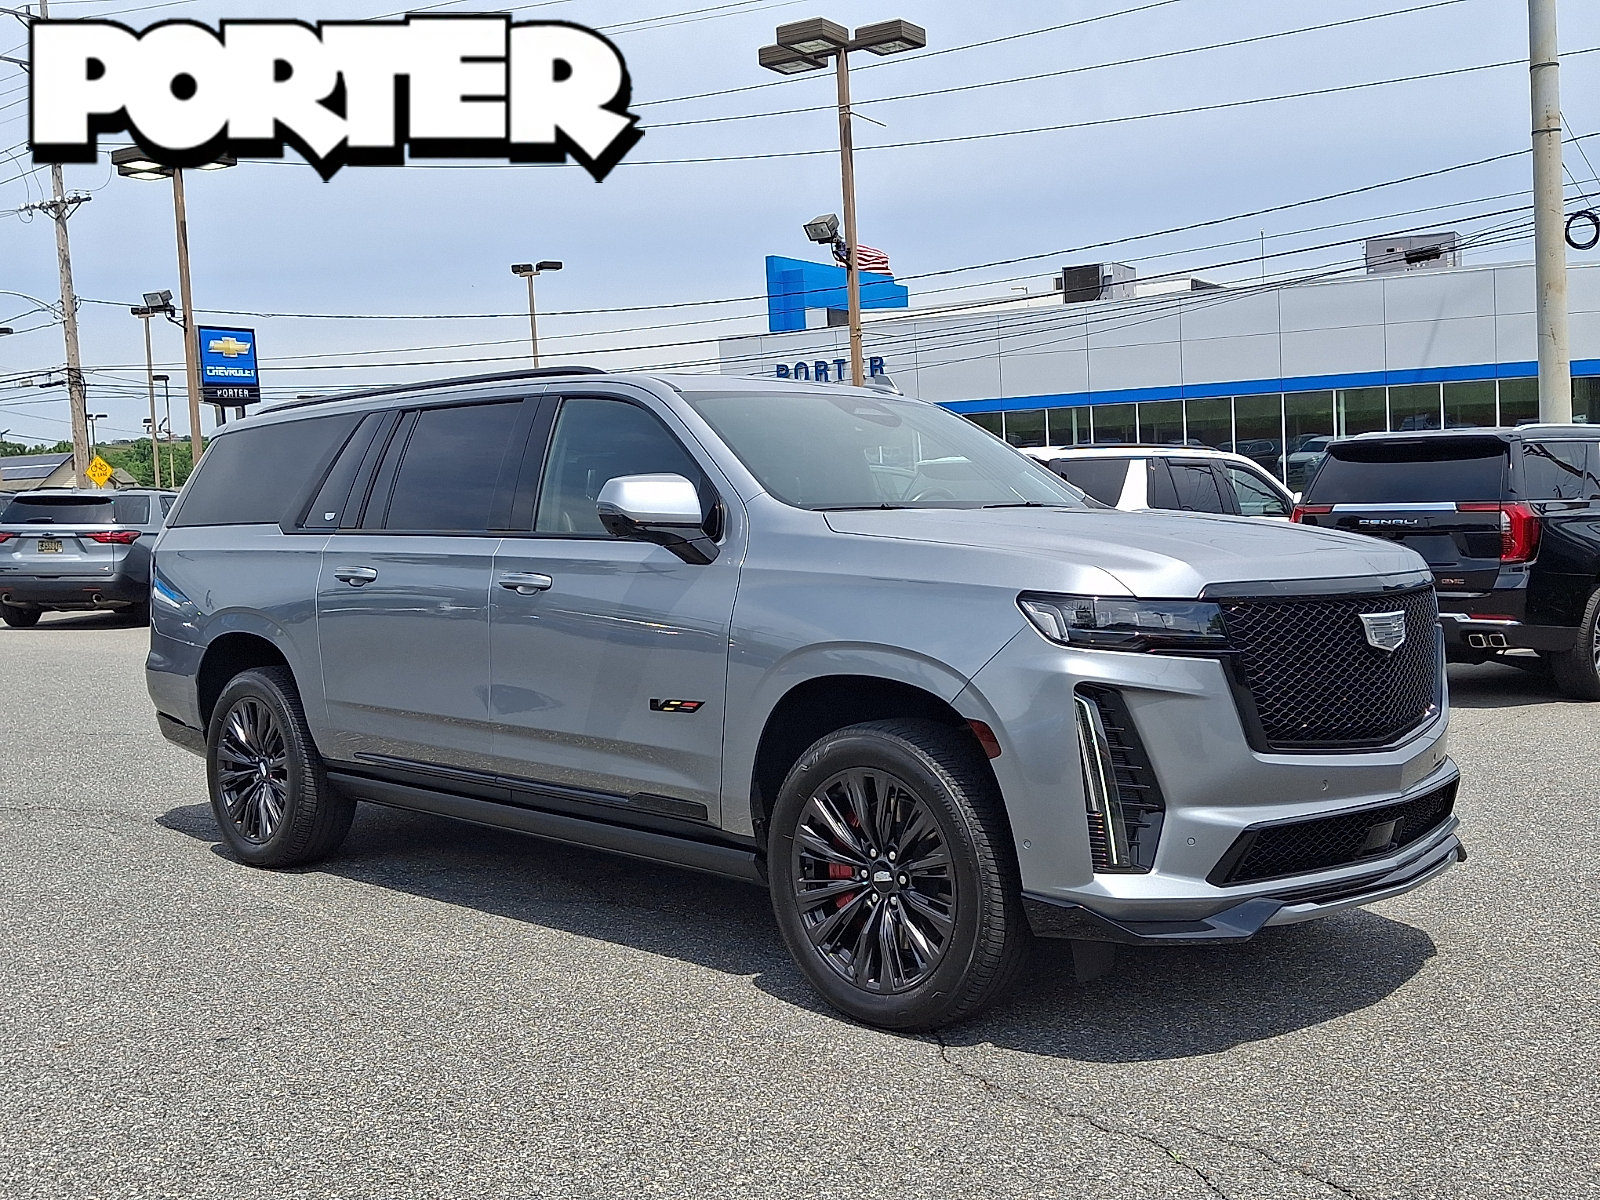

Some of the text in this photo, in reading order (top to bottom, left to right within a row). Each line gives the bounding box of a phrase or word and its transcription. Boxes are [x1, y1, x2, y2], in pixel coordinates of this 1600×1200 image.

[206, 366, 254, 377] CHEVROLET
[776, 357, 885, 382] PORTR
[217, 389, 250, 398] PORTER
